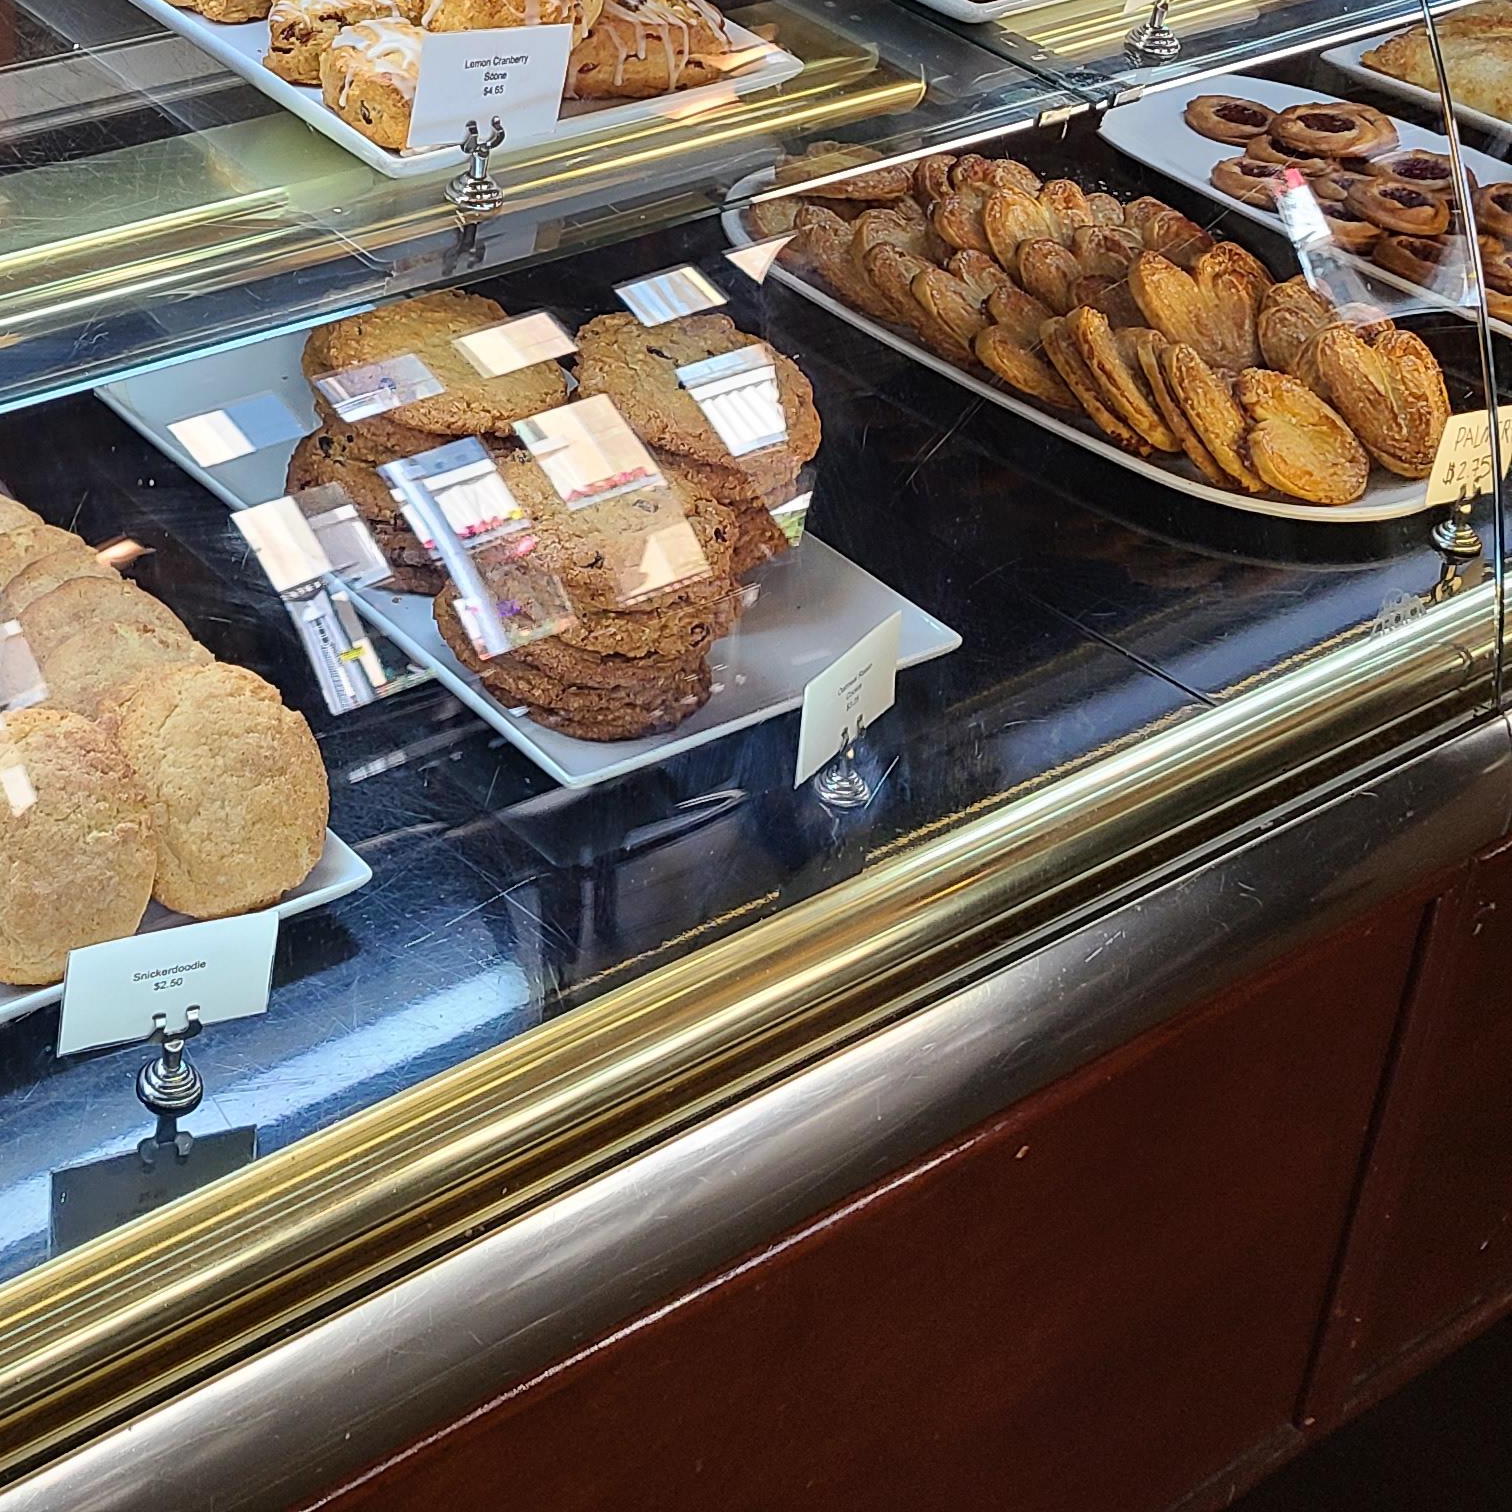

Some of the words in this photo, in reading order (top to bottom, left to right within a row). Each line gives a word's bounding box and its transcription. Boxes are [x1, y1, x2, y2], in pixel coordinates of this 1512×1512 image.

[464, 57, 492, 69] Lemon
[492, 54, 529, 68] Cranberry
[483, 71, 508, 82] Scone
[483, 85, 505, 97] $4.65
[1442, 454, 1492, 485] $2.75
[132, 959, 208, 982] Snickerdoodle
[153, 977, 184, 992] $2.50
